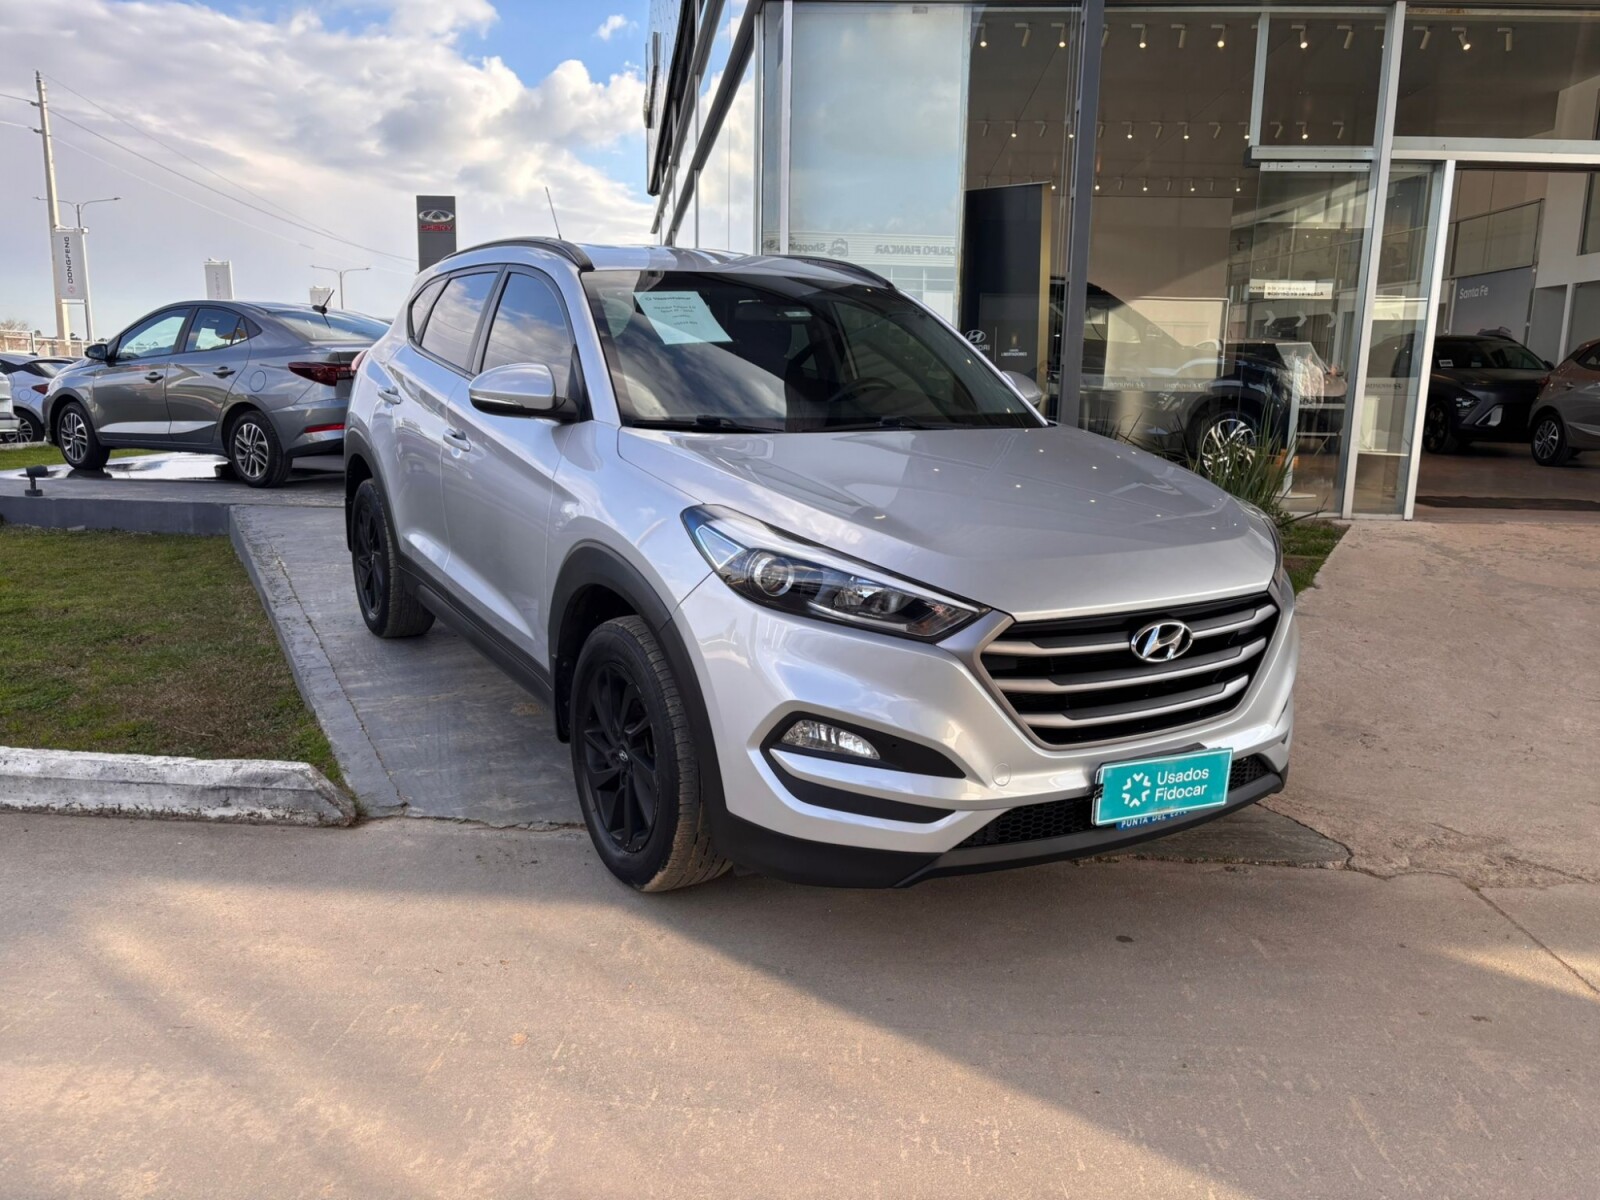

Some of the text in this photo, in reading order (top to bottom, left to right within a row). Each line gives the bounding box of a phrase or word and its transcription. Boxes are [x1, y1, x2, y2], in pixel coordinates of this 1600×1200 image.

[420, 224, 454, 232] CHERY
[64, 236, 74, 285] DONGFENG
[1459, 284, 1489, 299] Santa Fe
[1156, 767, 1209, 786] Usados
[1154, 783, 1208, 802] Fidocar
